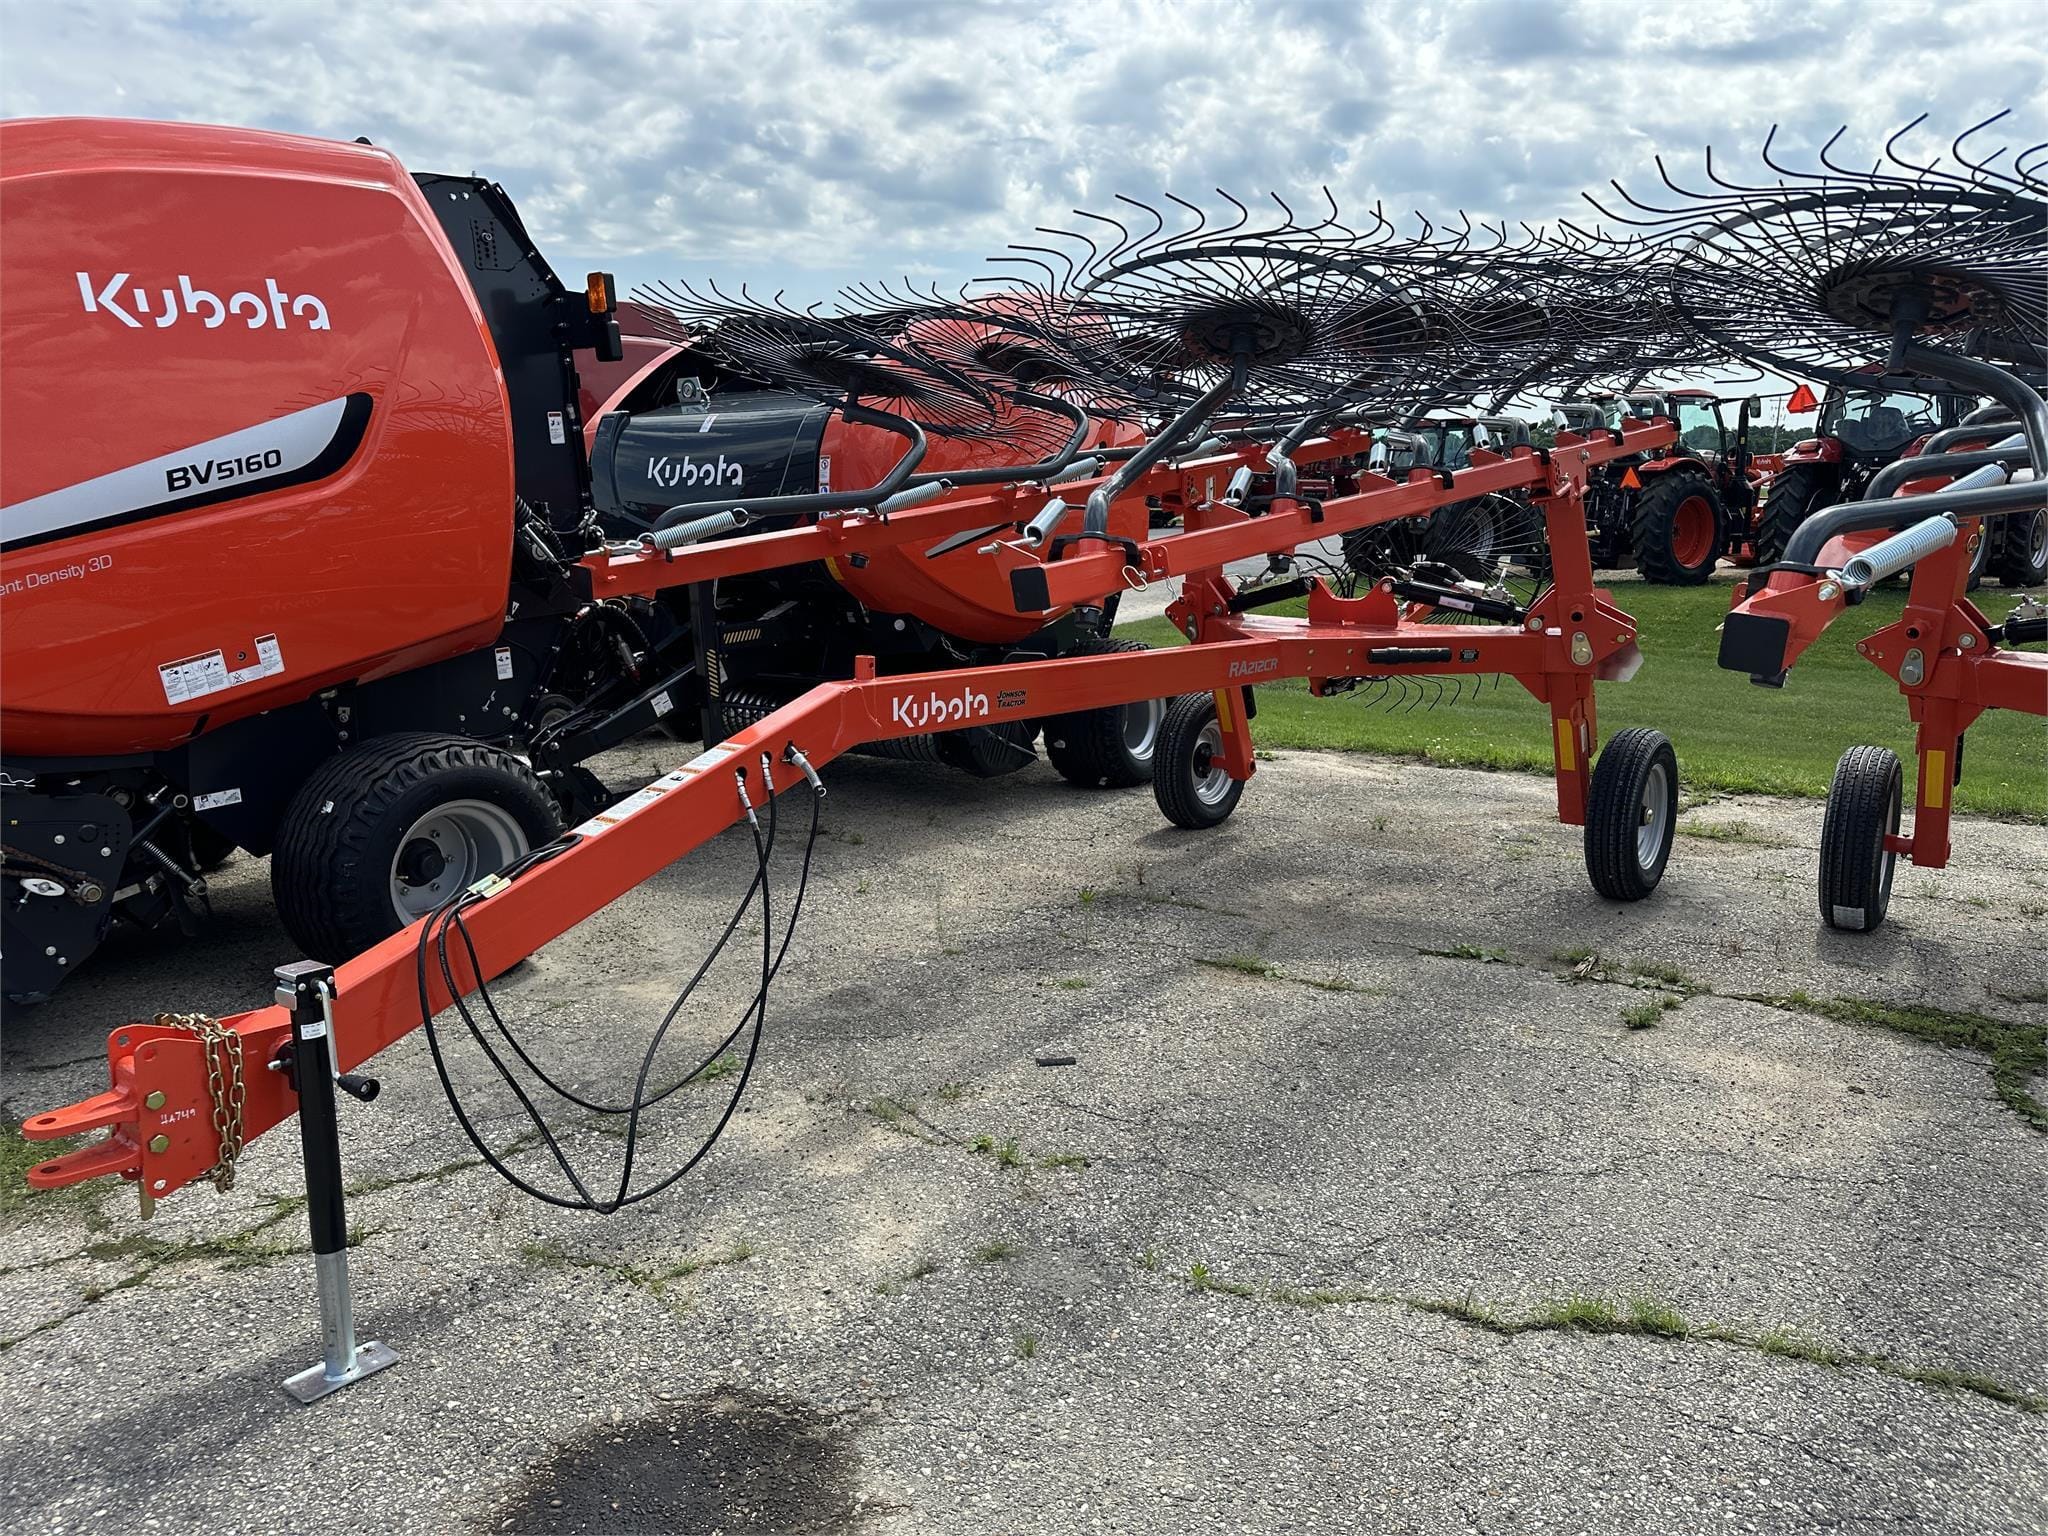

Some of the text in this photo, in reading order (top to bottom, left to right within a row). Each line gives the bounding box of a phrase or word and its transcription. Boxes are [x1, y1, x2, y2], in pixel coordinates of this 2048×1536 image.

[76, 272, 331, 330] Kubota
[166, 449, 281, 492] BV5160
[648, 455, 743, 487] Kubota
[26, 564, 85, 588] Density
[88, 555, 112, 572] 3D
[1229, 658, 1278, 678] RA212CR
[893, 687, 988, 728] Kubota
[997, 690, 1026, 700] JOHNSON
[998, 699, 1025, 708] TRACTOR
